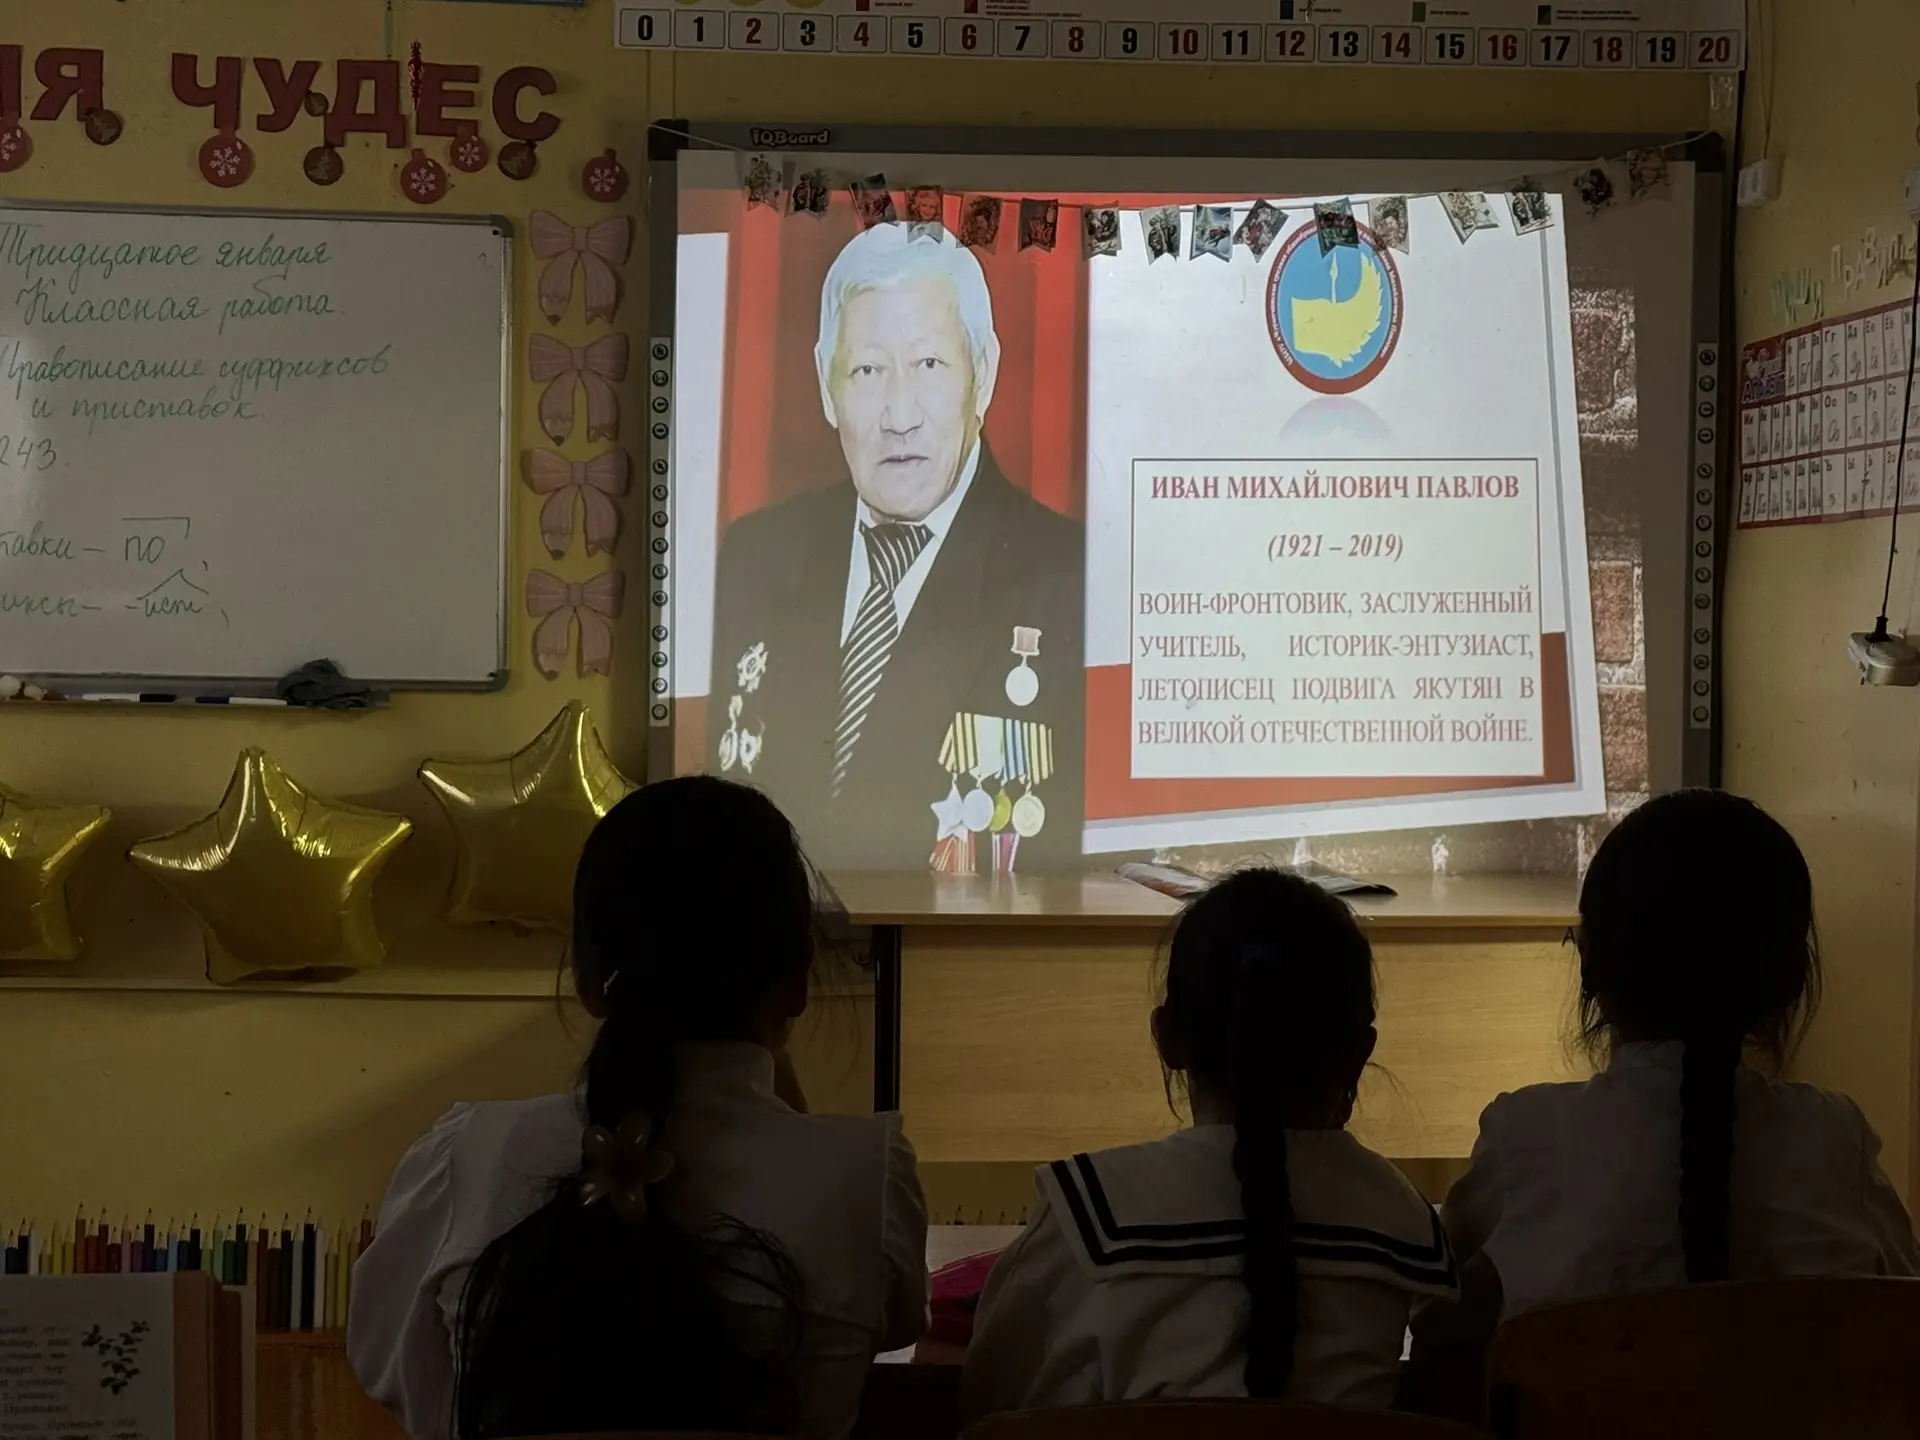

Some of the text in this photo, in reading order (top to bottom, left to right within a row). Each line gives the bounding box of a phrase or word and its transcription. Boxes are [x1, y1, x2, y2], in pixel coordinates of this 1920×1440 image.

[638, 15, 1730, 63] 0 1 2 3 4 5 6 7 8 9 10 11 12 13 14 15 16 17 18 19 20
[171, 52, 560, 148] ЧУДЕС
[216, 232, 332, 277] января
[16, 277, 211, 325] Классная
[32, 397, 55, 419] и
[1150, 470, 1520, 499] ИВАН МИХАЙЛОВИЧ ПАВЛОВ
[1268, 533, 1324, 562] (1921
[1348, 533, 1404, 562] 2019)
[1139, 586, 1533, 618] ВОИН-ФРОНТОВИК, ЗАСЛУЖЕННЫЙ
[1139, 633, 1535, 661] УЧИТЕЛЬ, ИСТОРИК-ЭНТУЗИАСТ,
[1138, 677, 1535, 704] ЛЕТОПИСЕЦ ПОДВИГА ЯКУТЯН В
[1138, 713, 1534, 745] ВЕЛИКОЙ ОТЕЧЕСТВЕННОЙ ВОЙНЕ.
